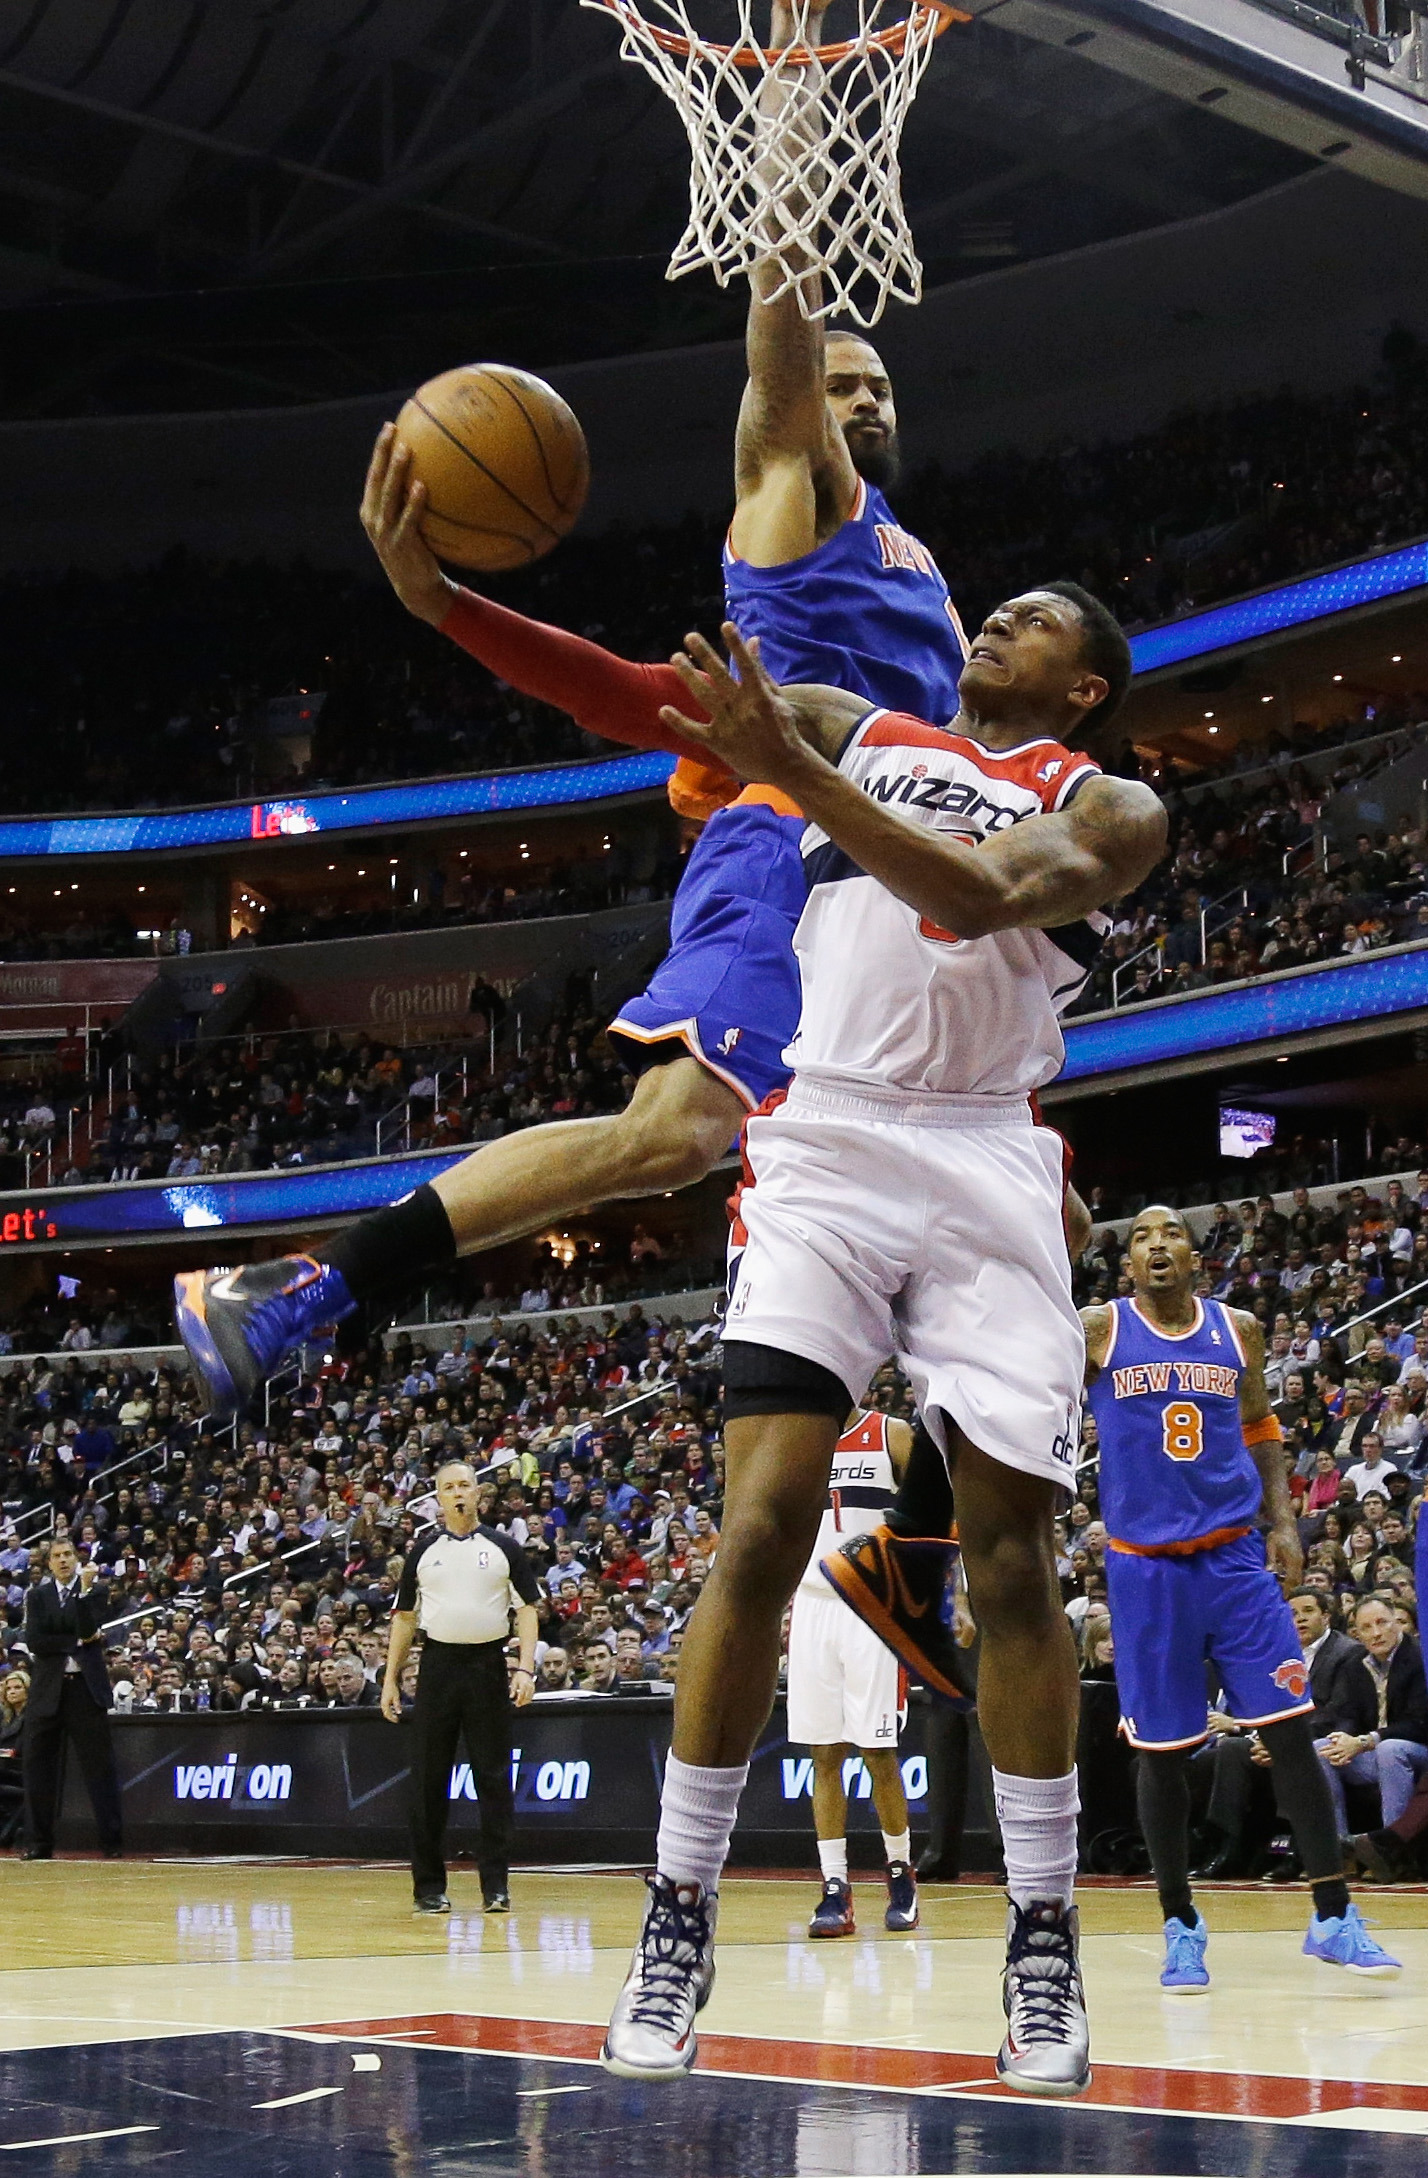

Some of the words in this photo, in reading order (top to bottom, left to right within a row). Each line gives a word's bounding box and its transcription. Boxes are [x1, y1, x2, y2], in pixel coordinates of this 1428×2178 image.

[862, 766, 1038, 833] wizard
[0, 1208, 57, 1241] et's
[1112, 1362, 1173, 1399] NEW
[1172, 1361, 1239, 1399] YORK
[1161, 1401, 1204, 1462] 8
[830, 1459, 877, 1481] ards
